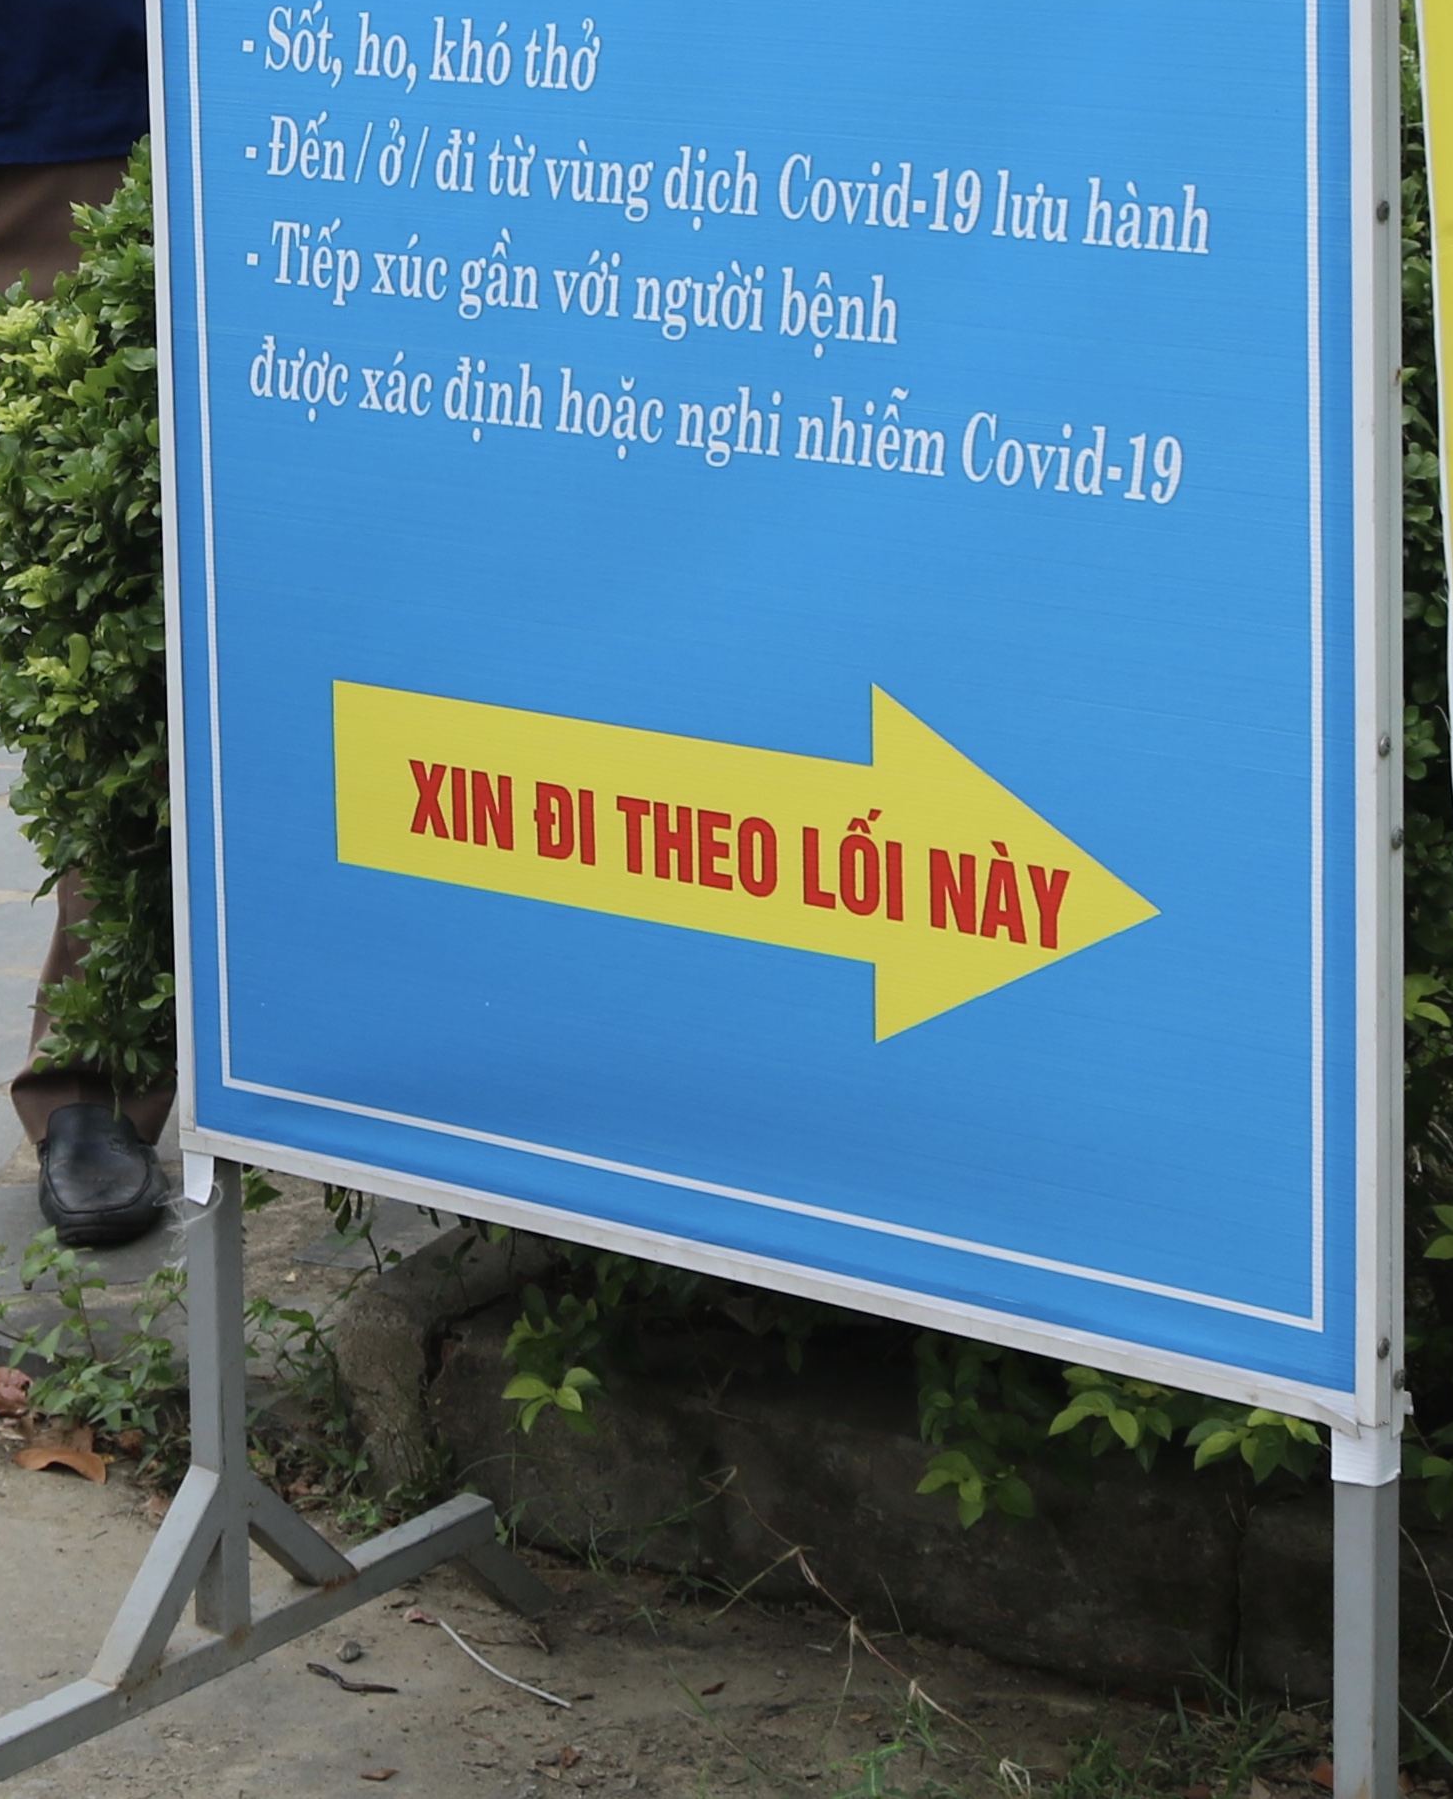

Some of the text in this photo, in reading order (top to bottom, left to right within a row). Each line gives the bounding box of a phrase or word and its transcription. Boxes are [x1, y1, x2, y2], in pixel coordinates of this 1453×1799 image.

[265, 0, 342, 87] Sốt,
[355, 12, 417, 92] ho,
[429, 16, 511, 85] khó
[525, 18, 600, 91] thở
[267, 111, 345, 181] Đến
[379, 118, 406, 186] ở
[436, 129, 476, 192] đi
[489, 135, 536, 197] từ
[545, 140, 654, 222] vùng
[664, 146, 758, 230] dịch
[779, 154, 981, 234] Covid-19
[992, 170, 1068, 242] lưu
[1082, 177, 1209, 254] hành
[272, 218, 360, 306] Tiếp
[372, 234, 448, 300] xúc
[459, 228, 538, 319] gần
[553, 250, 620, 317] với
[633, 261, 764, 340] người
[780, 267, 897, 358] bệnh
[250, 335, 1182, 504] được xác định hoặc nghi nhiễm Covid-19
[410, 760, 1070, 950] XIN ĐI THEO LỐI NÀY
